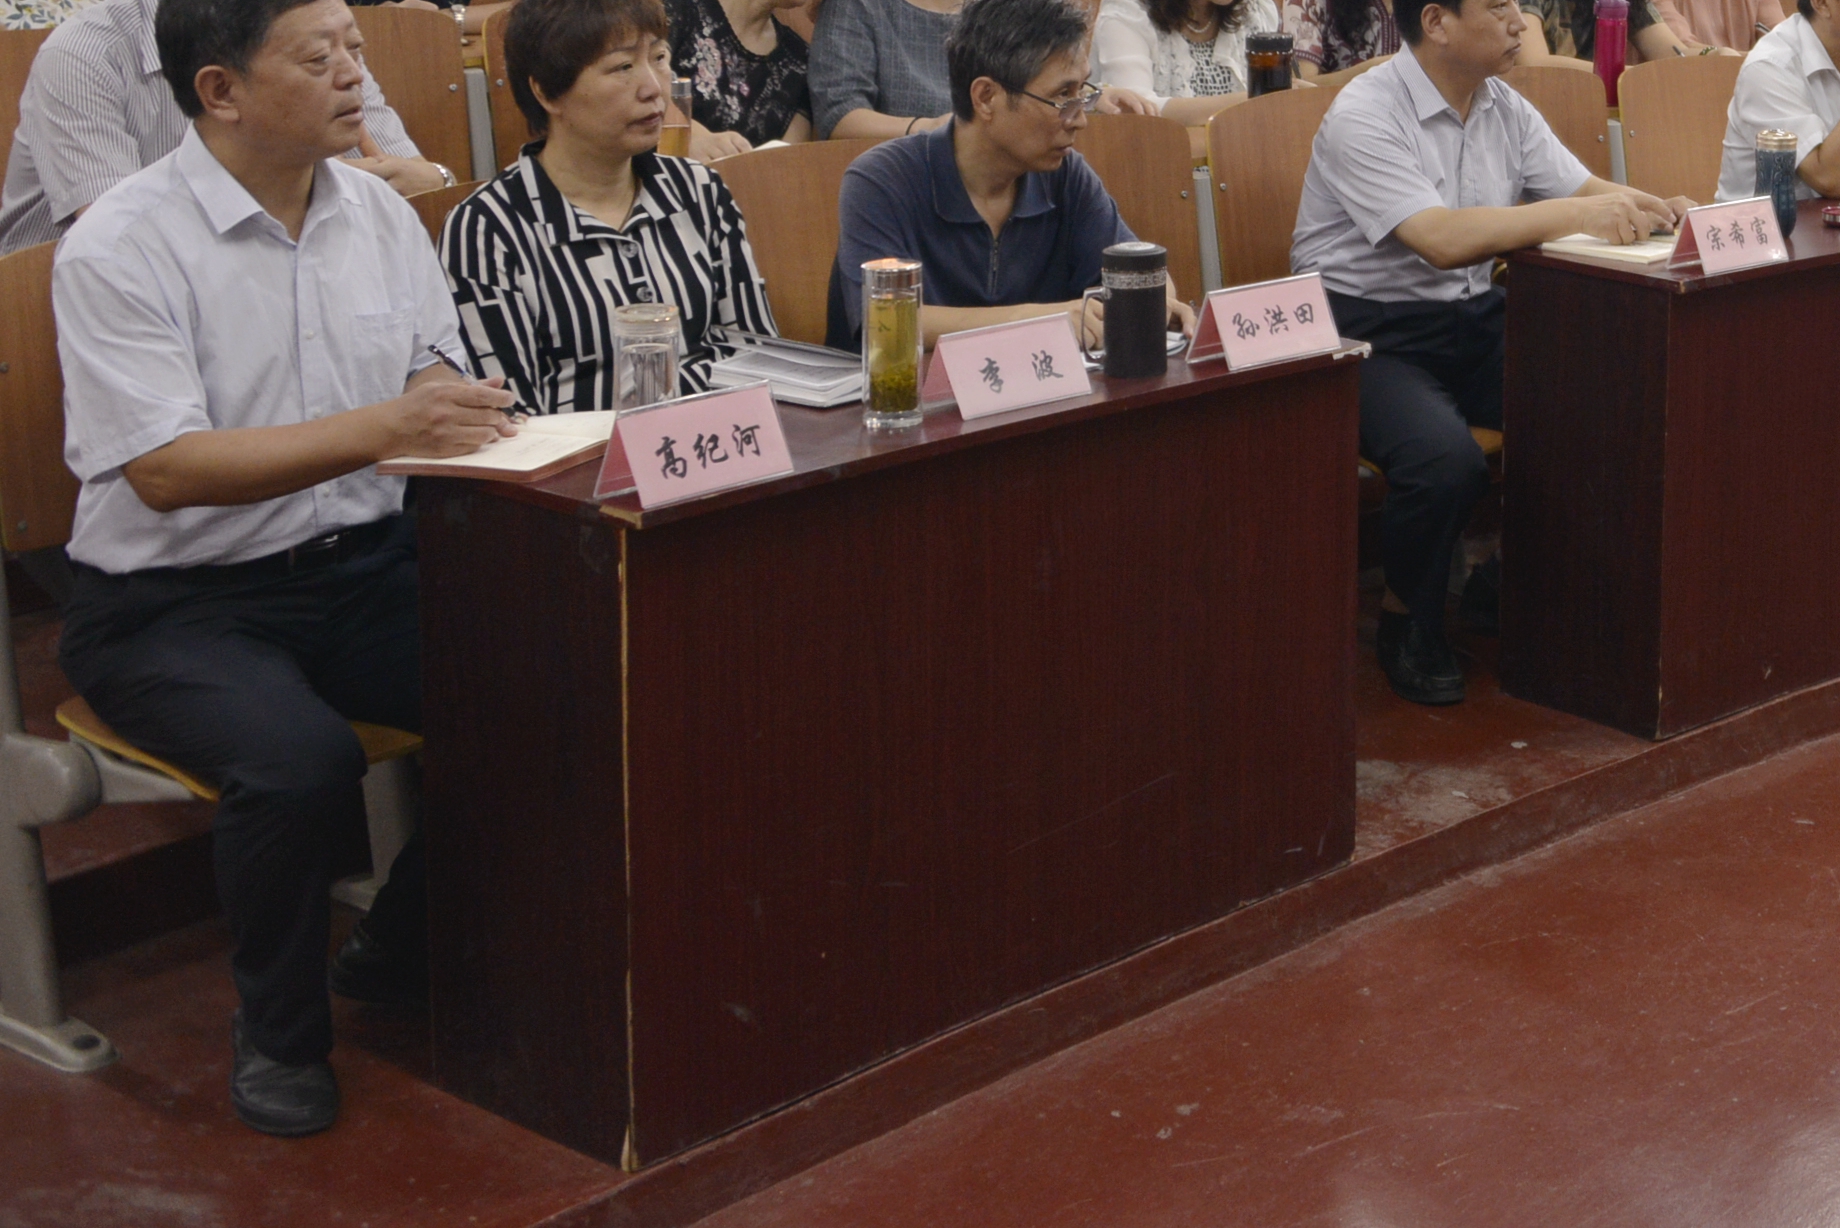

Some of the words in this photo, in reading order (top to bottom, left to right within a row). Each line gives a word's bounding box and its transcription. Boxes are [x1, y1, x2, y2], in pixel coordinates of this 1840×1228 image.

[1706, 216, 1768, 251] 宗希富
[1232, 302, 1314, 340] 孙洪田
[655, 423, 762, 479] 高纪河
